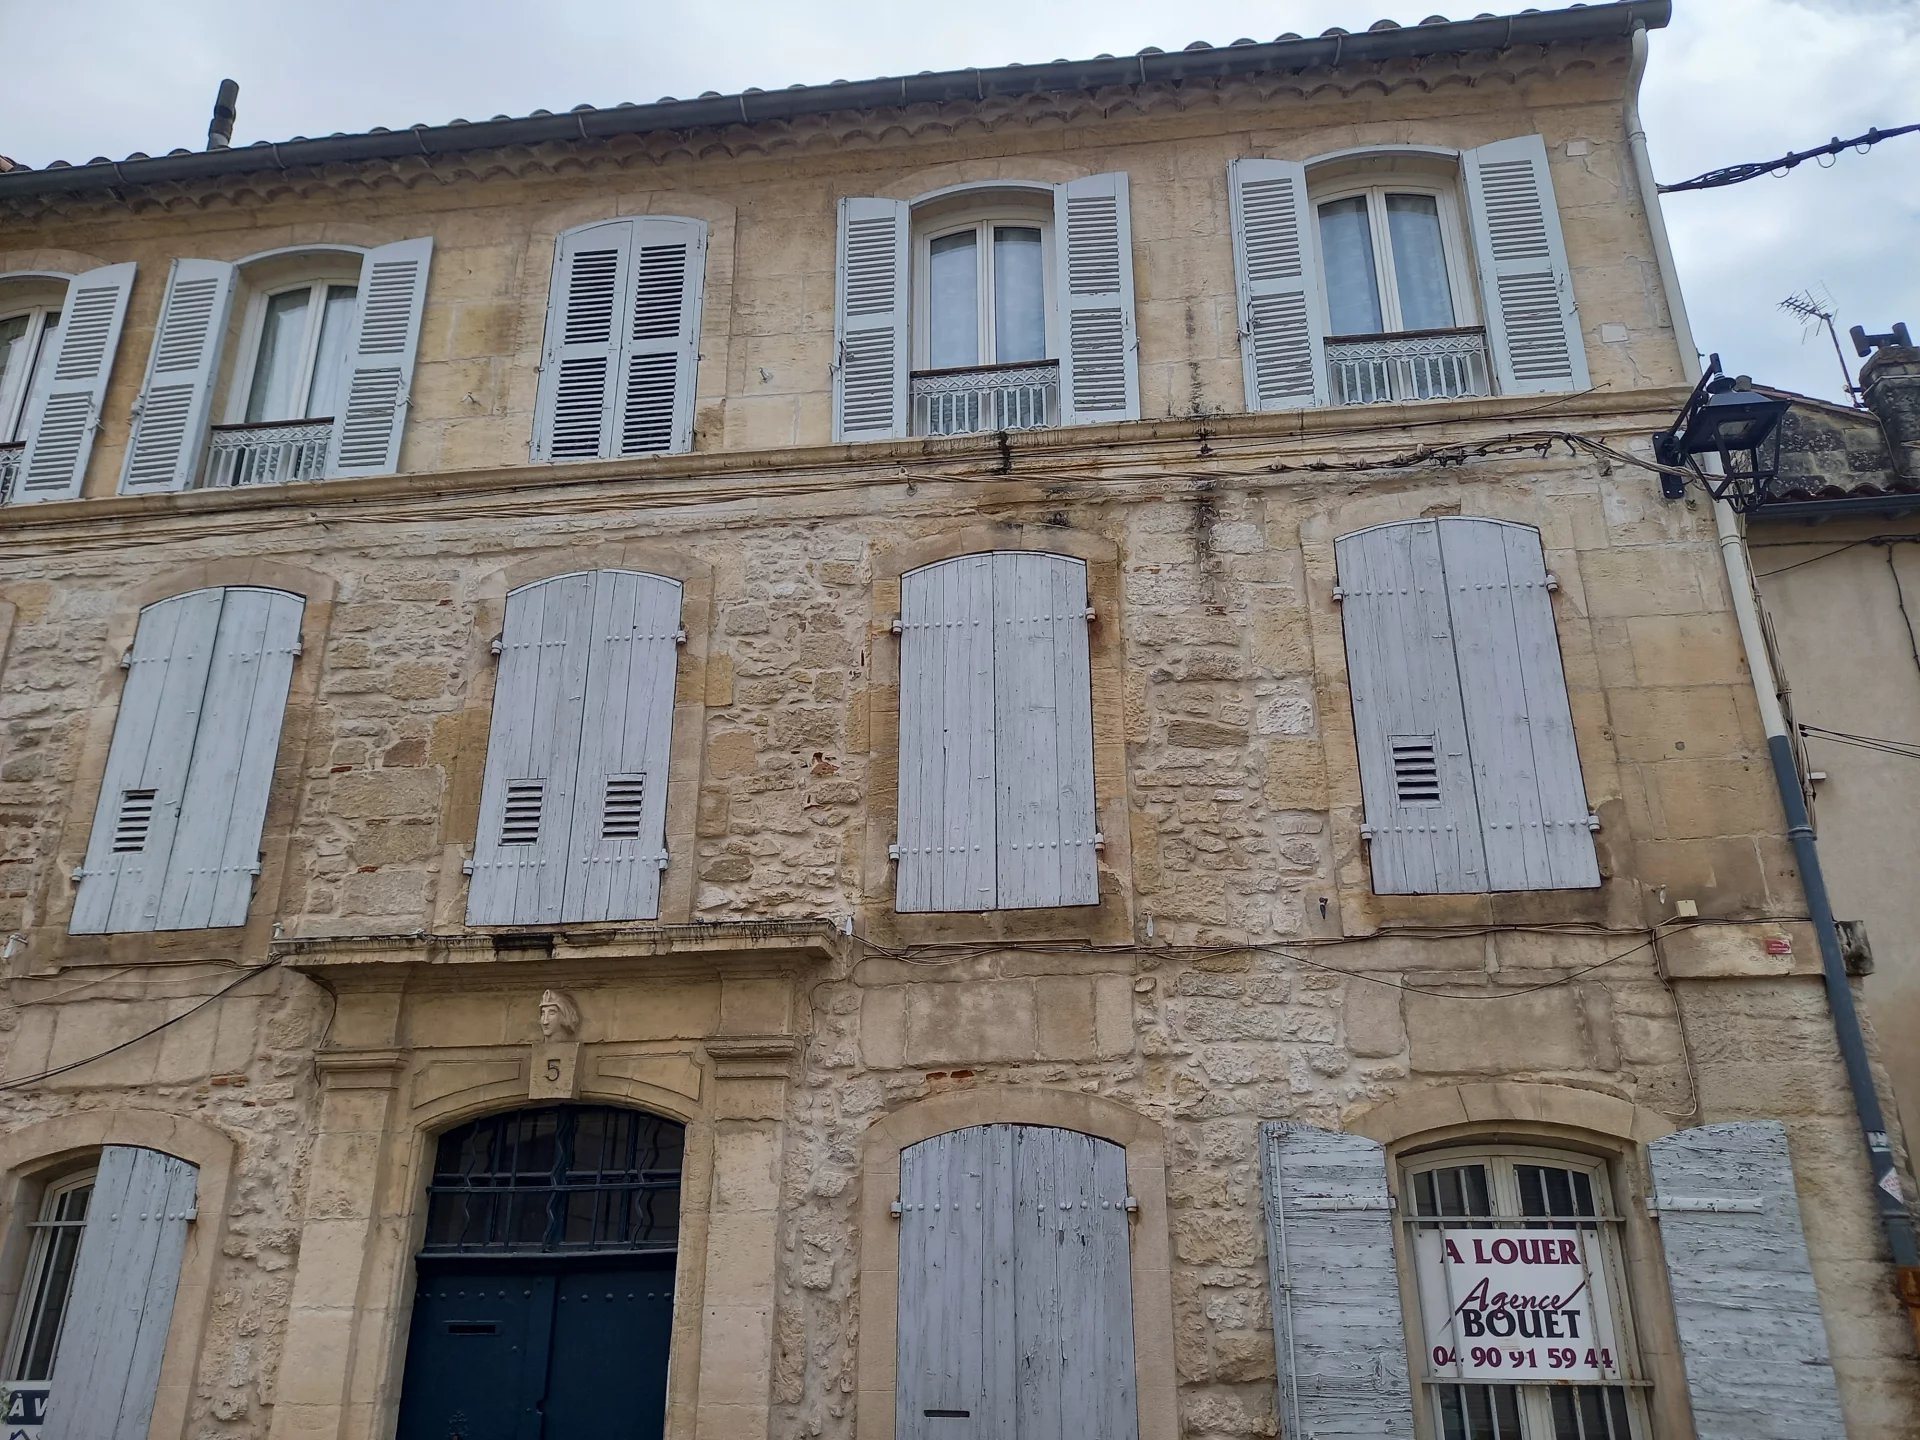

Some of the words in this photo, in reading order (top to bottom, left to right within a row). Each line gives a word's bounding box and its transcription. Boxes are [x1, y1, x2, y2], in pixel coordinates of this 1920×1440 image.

[545, 1058, 561, 1082] 5
[1440, 1238, 1465, 1264] A
[1472, 1238, 1582, 1265] LOUER
[1452, 1274, 1590, 1322] Agence
[1462, 1308, 1581, 1339] BOUET
[1470, 1346, 1502, 1368] 90
[1508, 1347, 1538, 1369] 91
[1547, 1347, 1577, 1369] 59
[1583, 1348, 1613, 1369] 44
[8, 1392, 25, 1417] À
